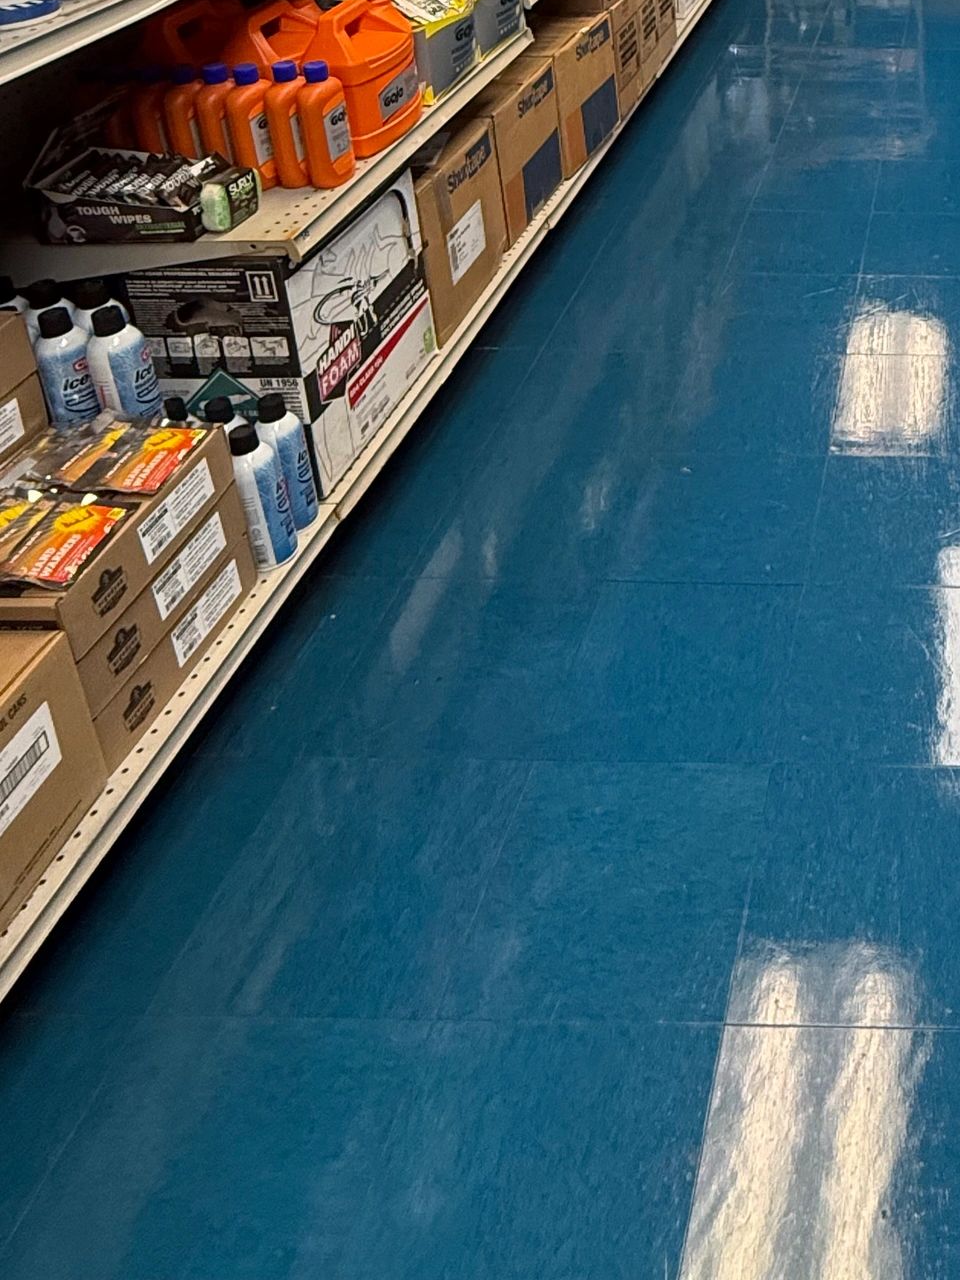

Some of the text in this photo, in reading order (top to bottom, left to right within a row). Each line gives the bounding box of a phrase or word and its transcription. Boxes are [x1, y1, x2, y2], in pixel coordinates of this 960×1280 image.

[447, 145, 488, 194] Shurtape
[227, 172, 254, 197] SURLY
[76, 205, 120, 216] TOUGH
[109, 214, 153, 225] WIPES
[319, 321, 356, 375] HANDI
[321, 339, 360, 400] FOAM
[260, 378, 299, 388] UN 1956
